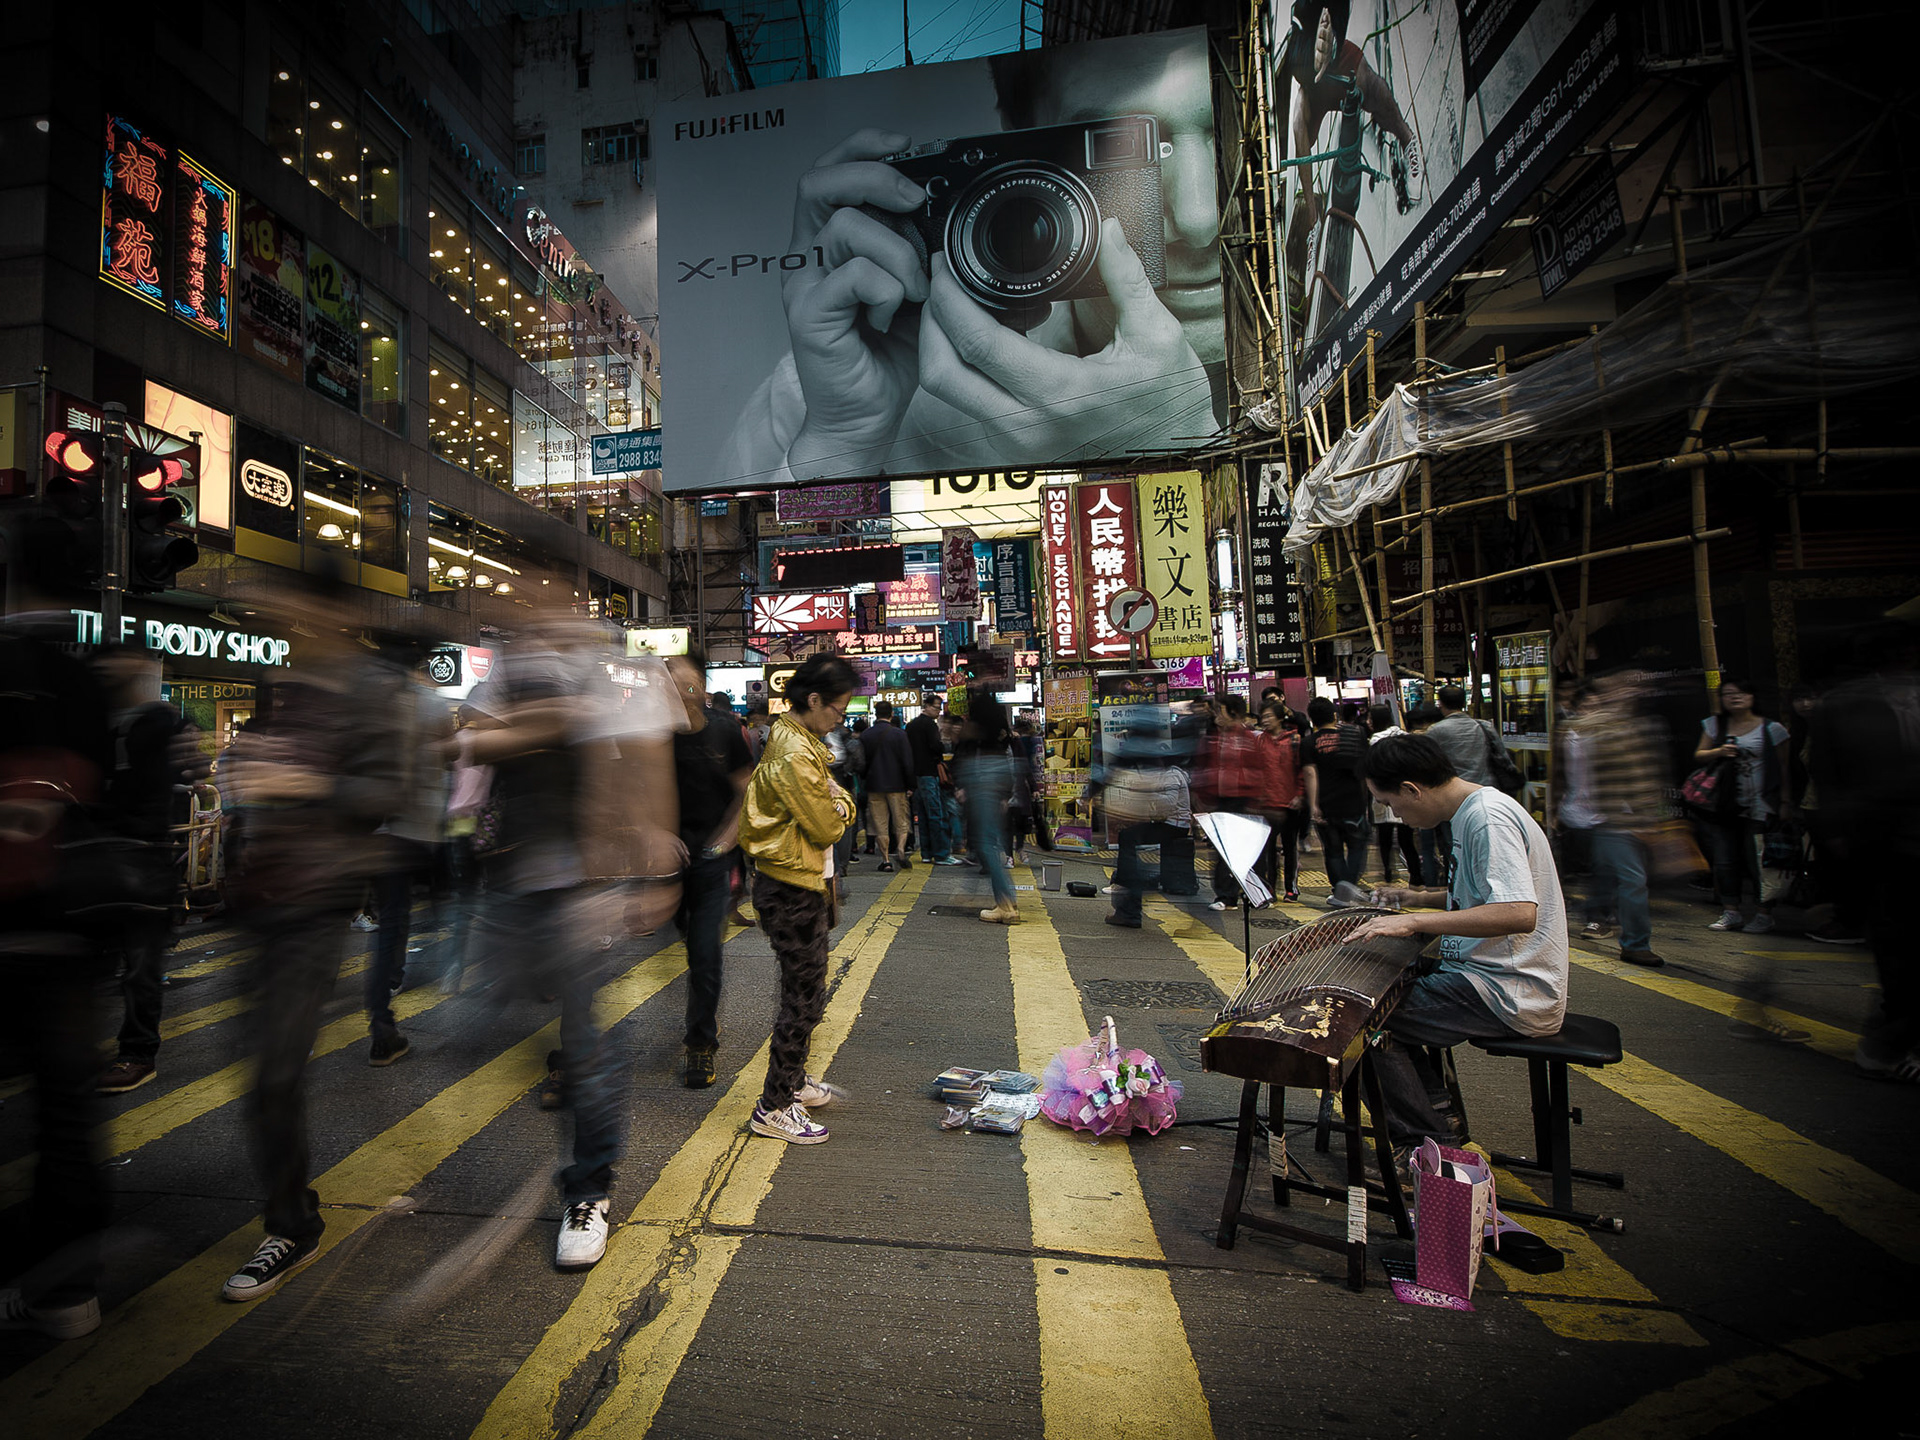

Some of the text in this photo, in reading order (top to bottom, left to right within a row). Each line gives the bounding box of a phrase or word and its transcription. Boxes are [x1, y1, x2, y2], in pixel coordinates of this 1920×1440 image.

[675, 108, 784, 141] FUJIFILM
[1489, 171, 1518, 208] Customer
[1517, 138, 1545, 178] Service
[116, 139, 163, 285] 福苑
[968, 178, 1077, 223] FUJINON ASPHERICAL LENS
[1563, 188, 1618, 248] AD HOTLINE
[188, 186, 209, 314] 火鍋海鮮酒家
[1564, 207, 1623, 268] 9699 2348
[677, 246, 824, 283] X-Pro1
[1046, 269, 1062, 283] EBC
[1061, 246, 1079, 271] SUPER
[1542, 263, 1566, 291] DWL
[1298, 348, 1333, 408] Timberland
[619, 452, 641, 468] 2988
[784, 486, 858, 505] 2332 0188
[1153, 485, 1195, 600] 樂文
[997, 543, 1018, 611] 序言書室
[1047, 490, 1073, 647] MONEY EXCHANGE
[814, 607, 845, 619] MX
[1158, 605, 1202, 633] 書店
[144, 619, 224, 659] BODY
[1258, 632, 1286, 645] 負離子
[1499, 645, 1547, 668] 陽光酒店
[180, 684, 208, 699] THE
[1102, 693, 1156, 706] AceNet
